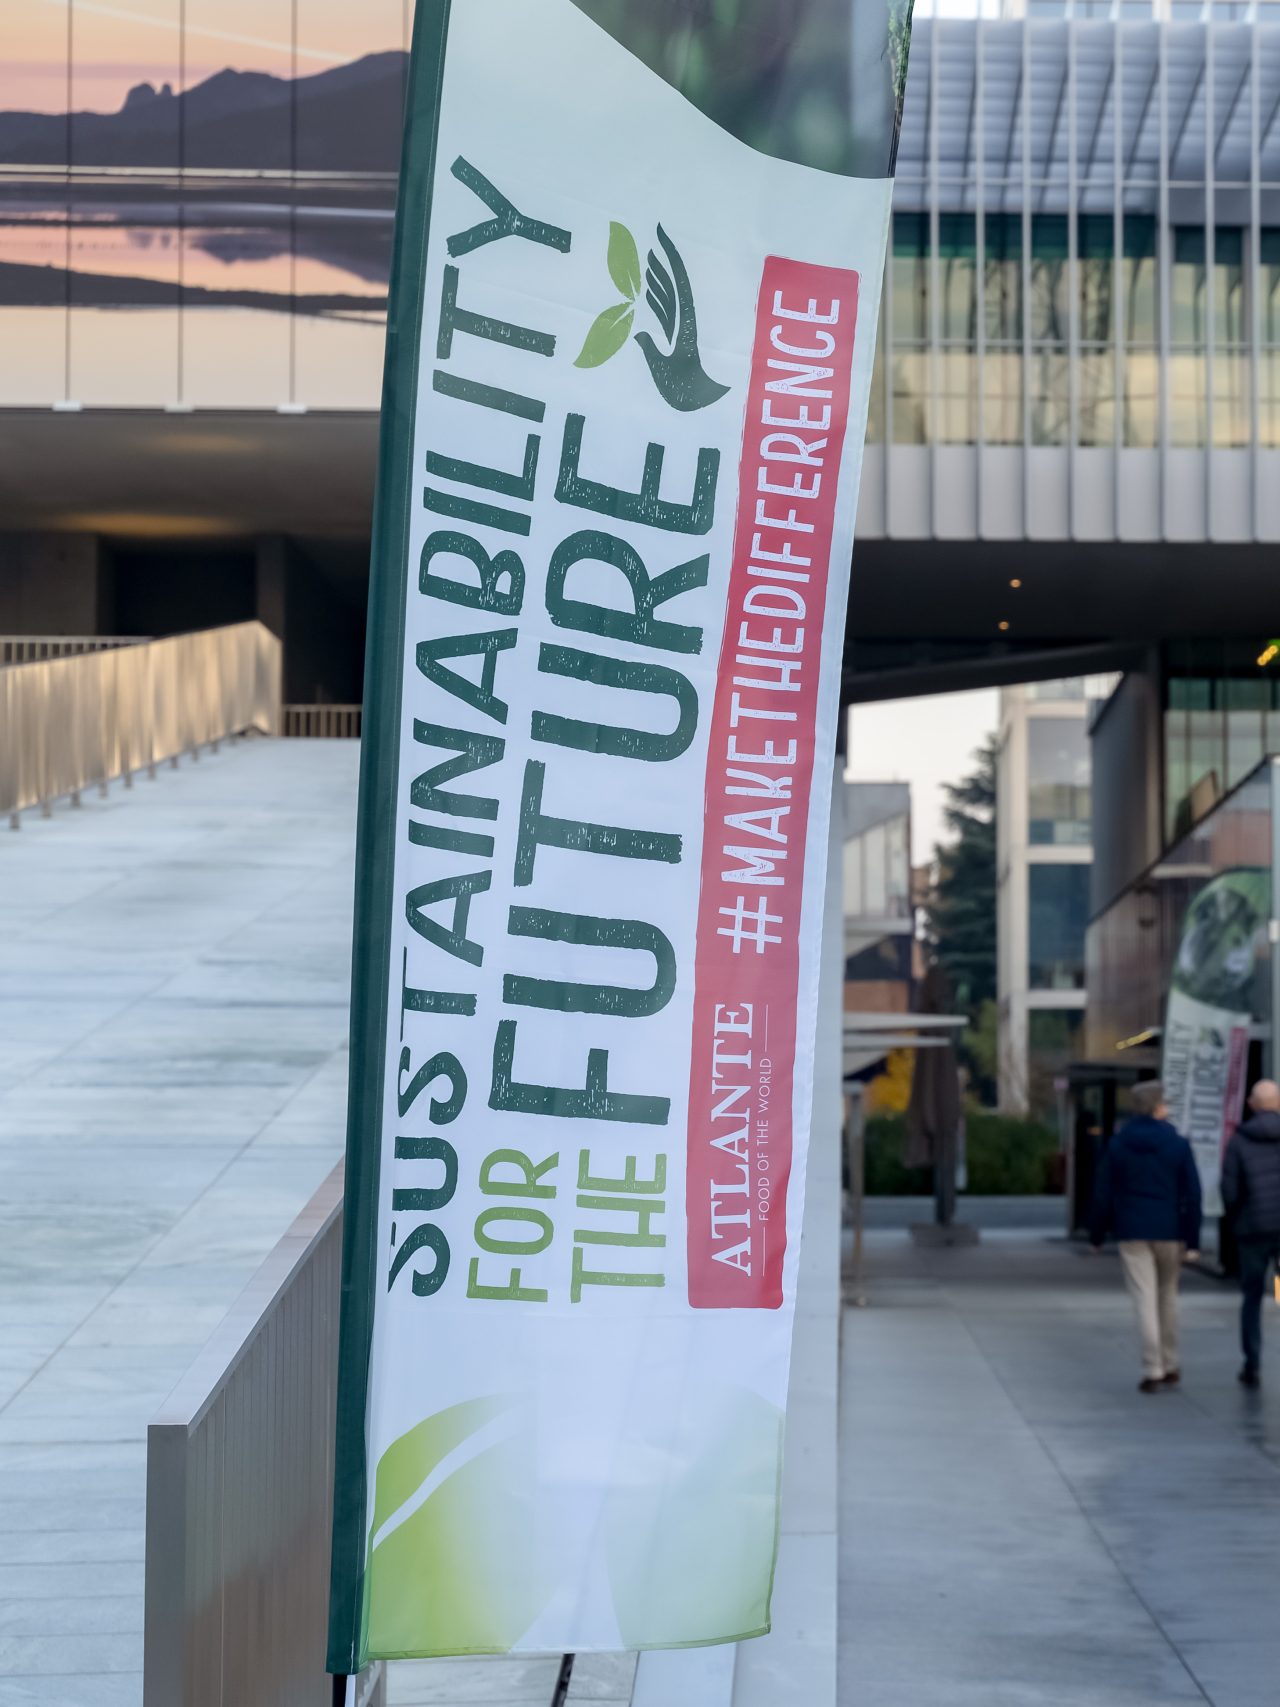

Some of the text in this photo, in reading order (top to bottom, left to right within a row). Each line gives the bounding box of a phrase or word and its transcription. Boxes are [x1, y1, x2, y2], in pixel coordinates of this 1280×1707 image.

[388, 155, 572, 1297] SUSTAINABILITY
[717, 290, 840, 955] #MAKETHEDIFFERENCE
[488, 412, 722, 1126] FUTURE
[466, 1148, 560, 1303] FOR
[570, 1148, 668, 1304] THE
[710, 1002, 753, 1277] ATLANTE
[756, 1058, 772, 1221] FOOD OF THE WORLD
